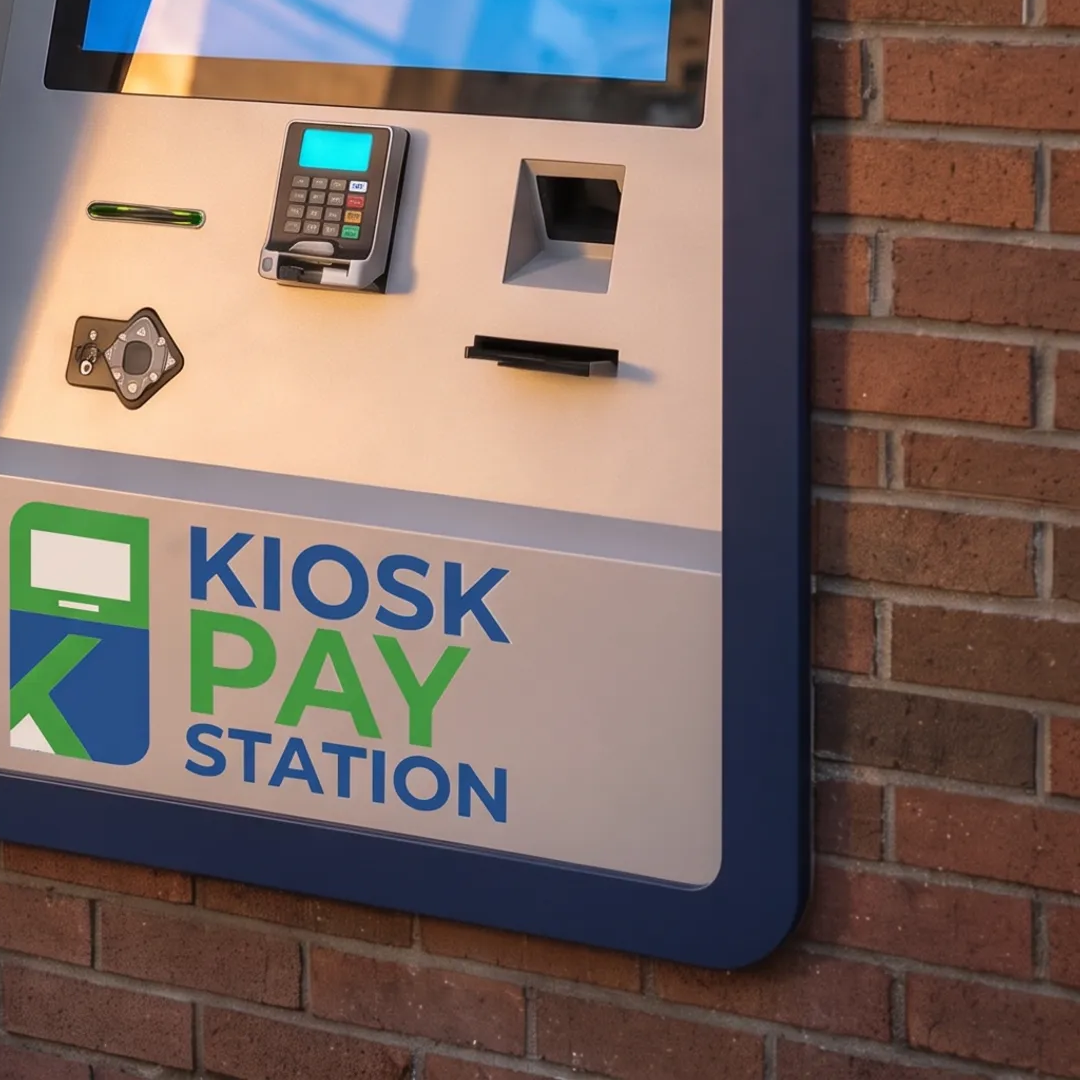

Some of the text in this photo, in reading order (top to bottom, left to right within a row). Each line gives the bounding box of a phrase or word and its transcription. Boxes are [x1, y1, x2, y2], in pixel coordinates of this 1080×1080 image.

[190, 525, 513, 644] KIOSK
[190, 608, 471, 748] PAY
[184, 723, 508, 823] STATION
